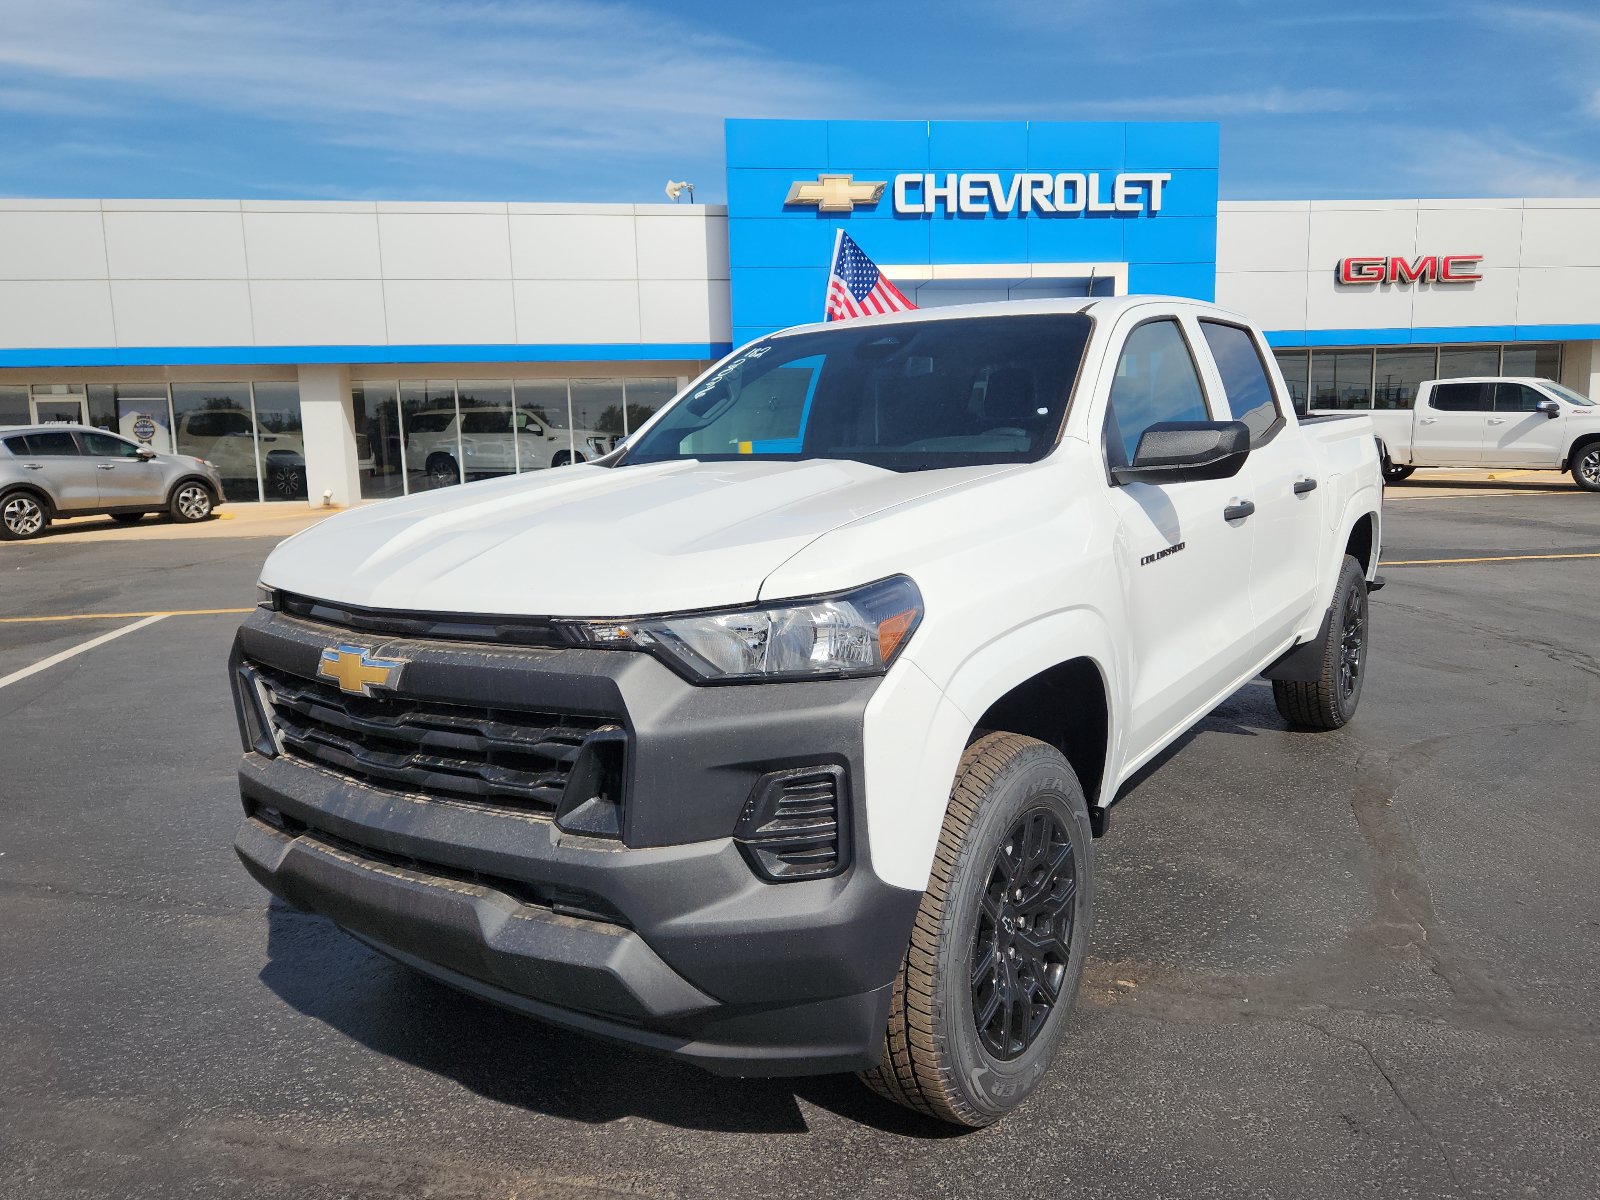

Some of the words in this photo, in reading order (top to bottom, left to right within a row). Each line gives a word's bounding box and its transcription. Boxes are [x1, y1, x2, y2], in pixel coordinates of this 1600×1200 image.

[894, 172, 1172, 213] CHEVROLET
[1339, 254, 1484, 284] GMC
[1140, 541, 1186, 566] COLORADO
